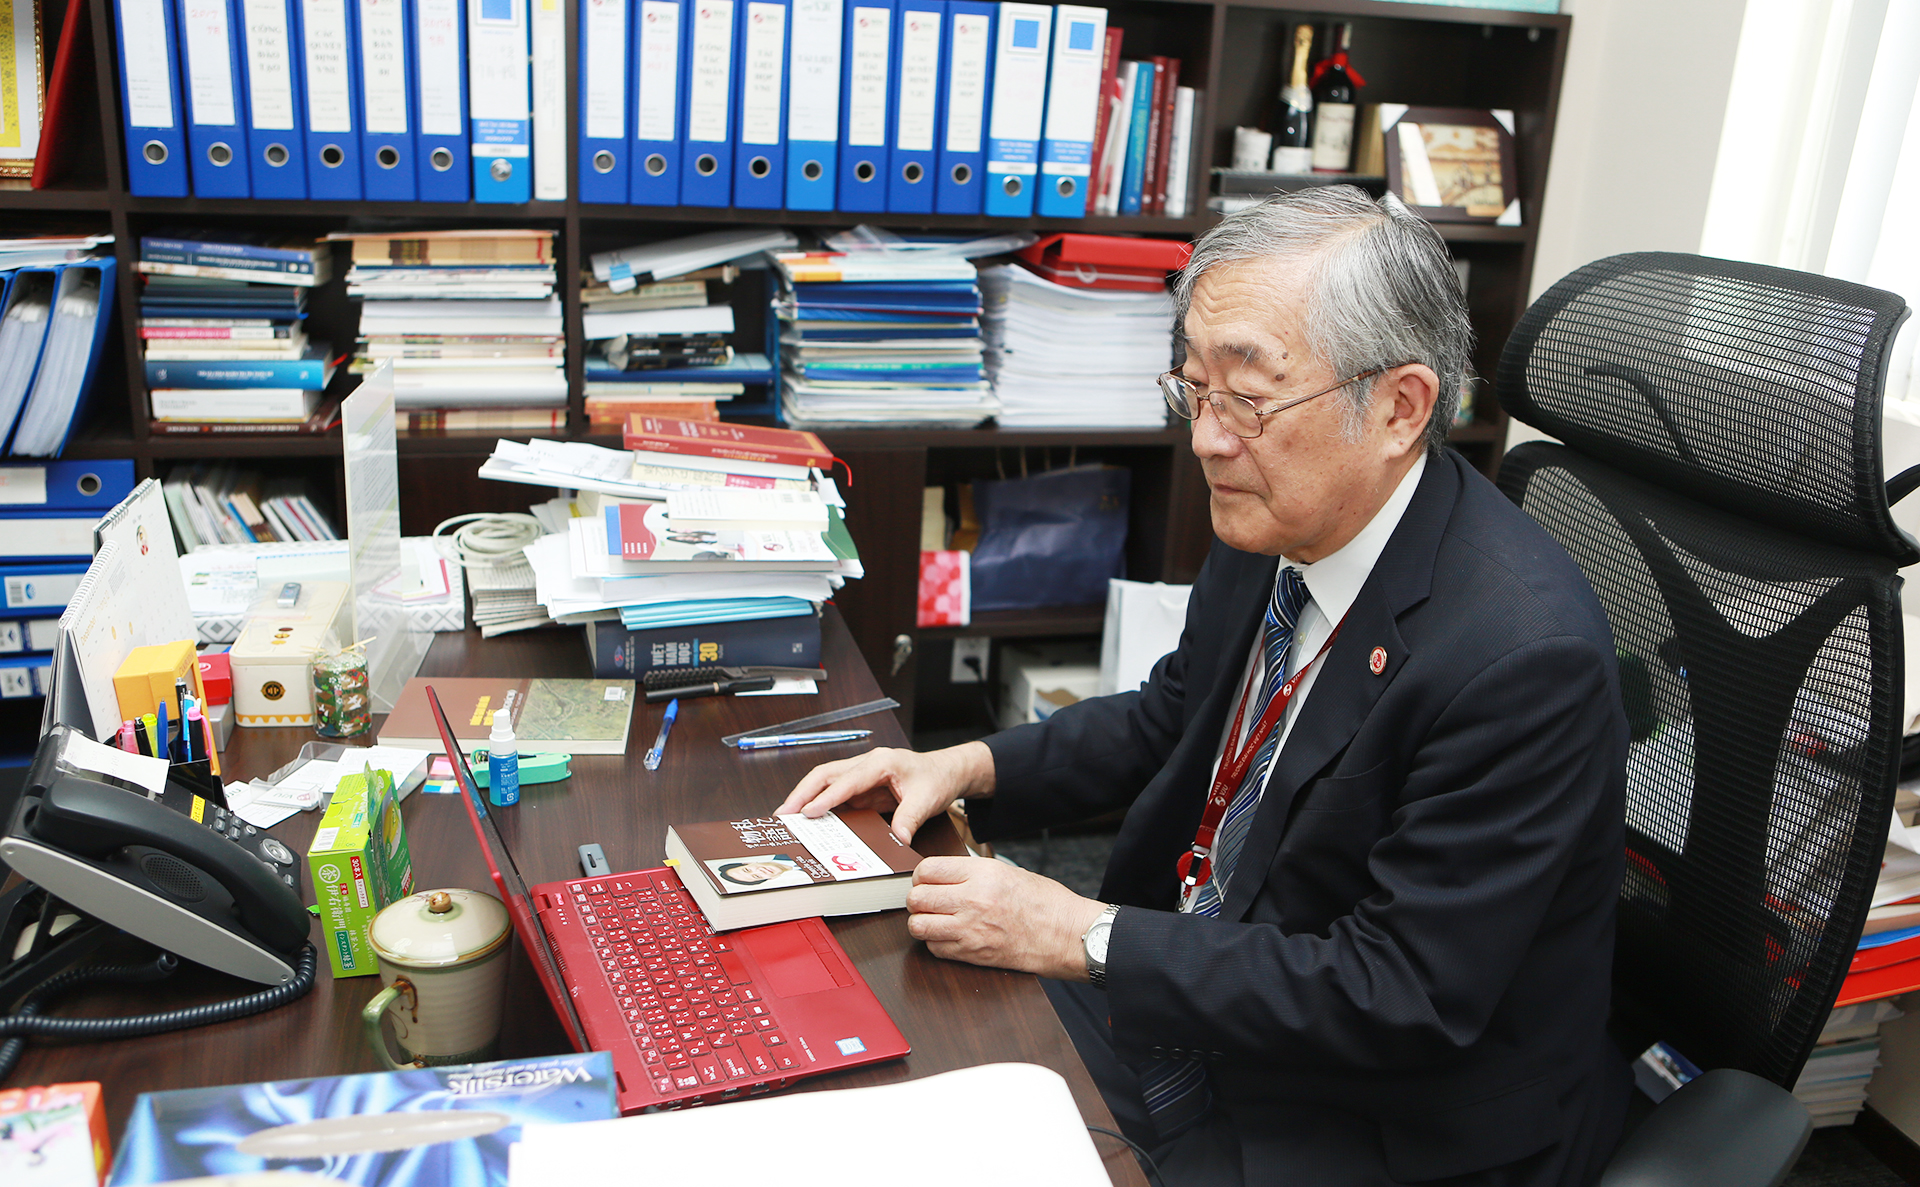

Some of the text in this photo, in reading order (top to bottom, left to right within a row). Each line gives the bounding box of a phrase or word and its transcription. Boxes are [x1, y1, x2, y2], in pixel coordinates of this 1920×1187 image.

[651, 643, 665, 666] VIỆT
[666, 642, 678, 666] NAM
[678, 642, 692, 664] HỌC
[700, 642, 718, 662] 30
[1220, 784, 1228, 796] VJU
[322, 868, 338, 880] 茶
[352, 858, 362, 878] 30本入
[326, 884, 346, 929] 伊右衛門
[338, 933, 354, 968] インスタント緑茶
[350, 930, 360, 952] 抹茶入り
[446, 1066, 593, 1094] Watersilk
